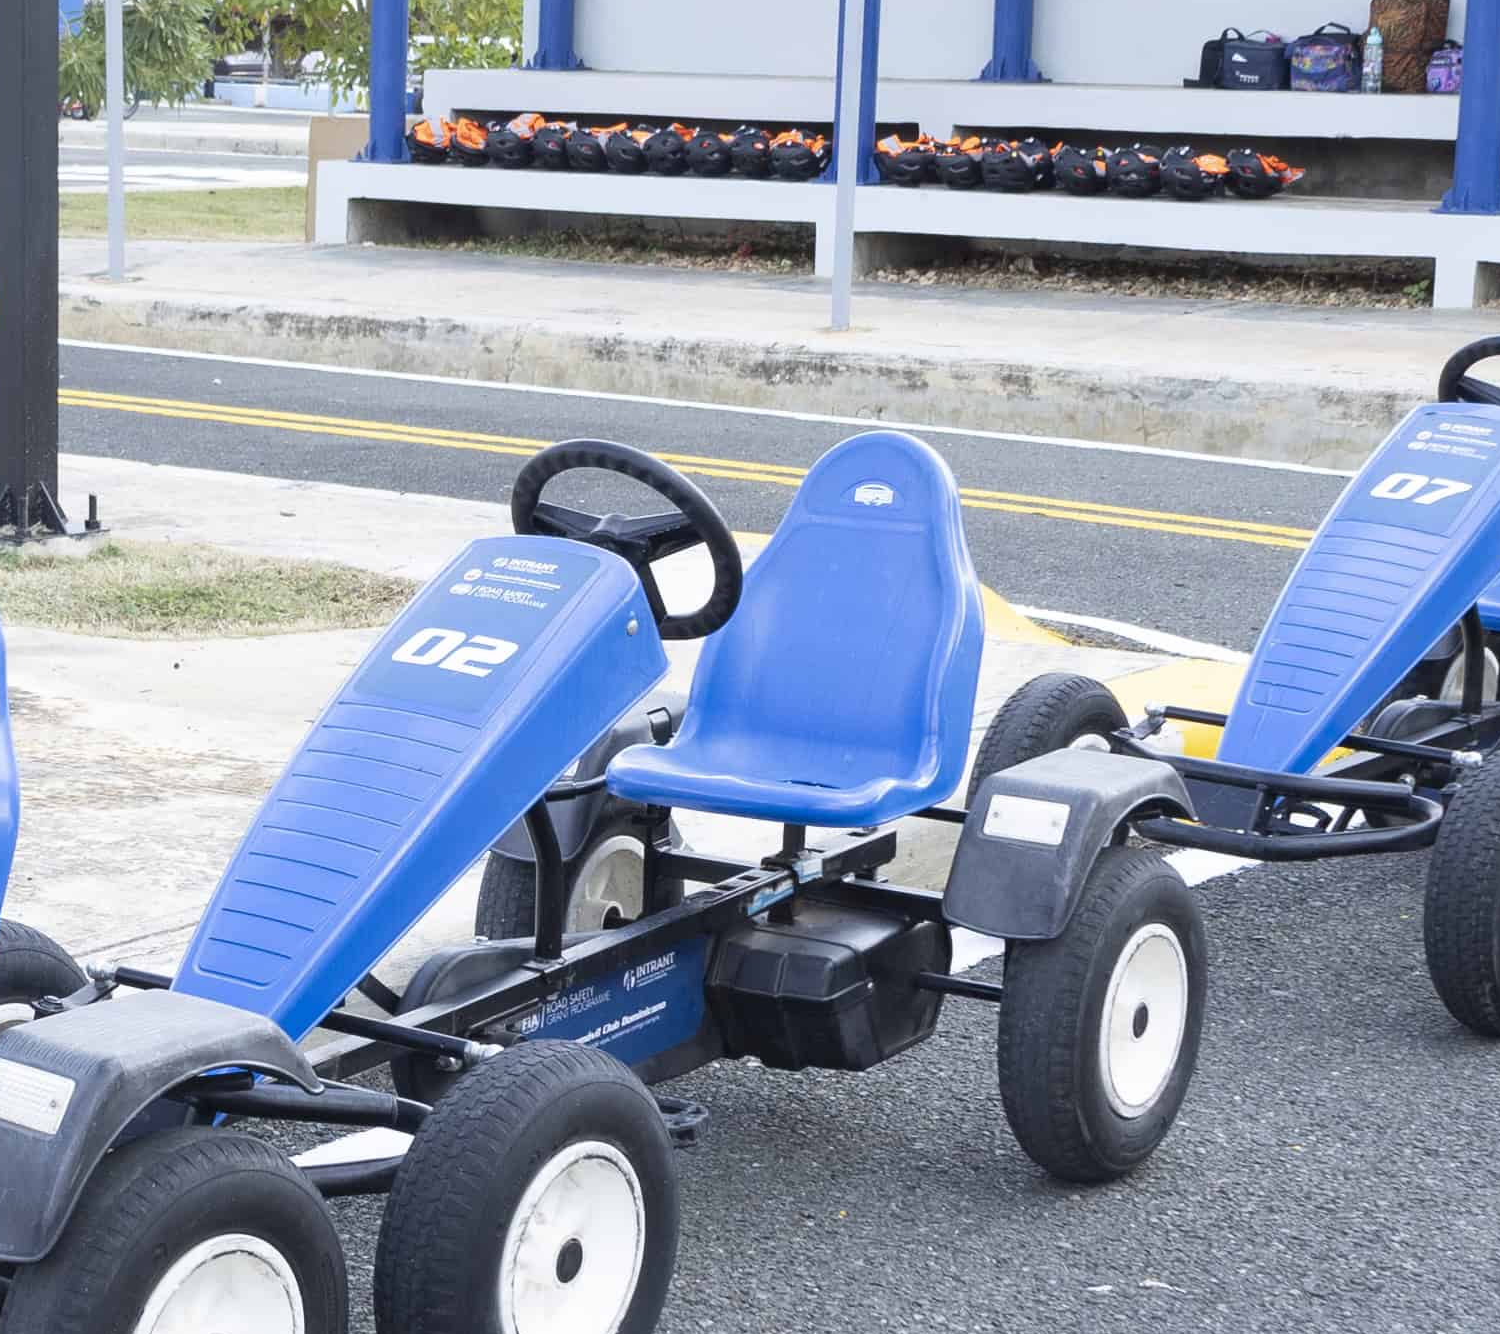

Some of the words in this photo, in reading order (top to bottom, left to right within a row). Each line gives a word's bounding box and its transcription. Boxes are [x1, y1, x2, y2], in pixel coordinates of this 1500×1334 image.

[1369, 472, 1473, 505] 07
[391, 627, 520, 678] 02
[634, 951, 677, 979] INTRANT
[546, 996, 568, 1014] ROAD
[568, 984, 595, 1005] SAFETY
[602, 1019, 621, 1035] Club
[620, 1000, 668, 1027] Dominicano
